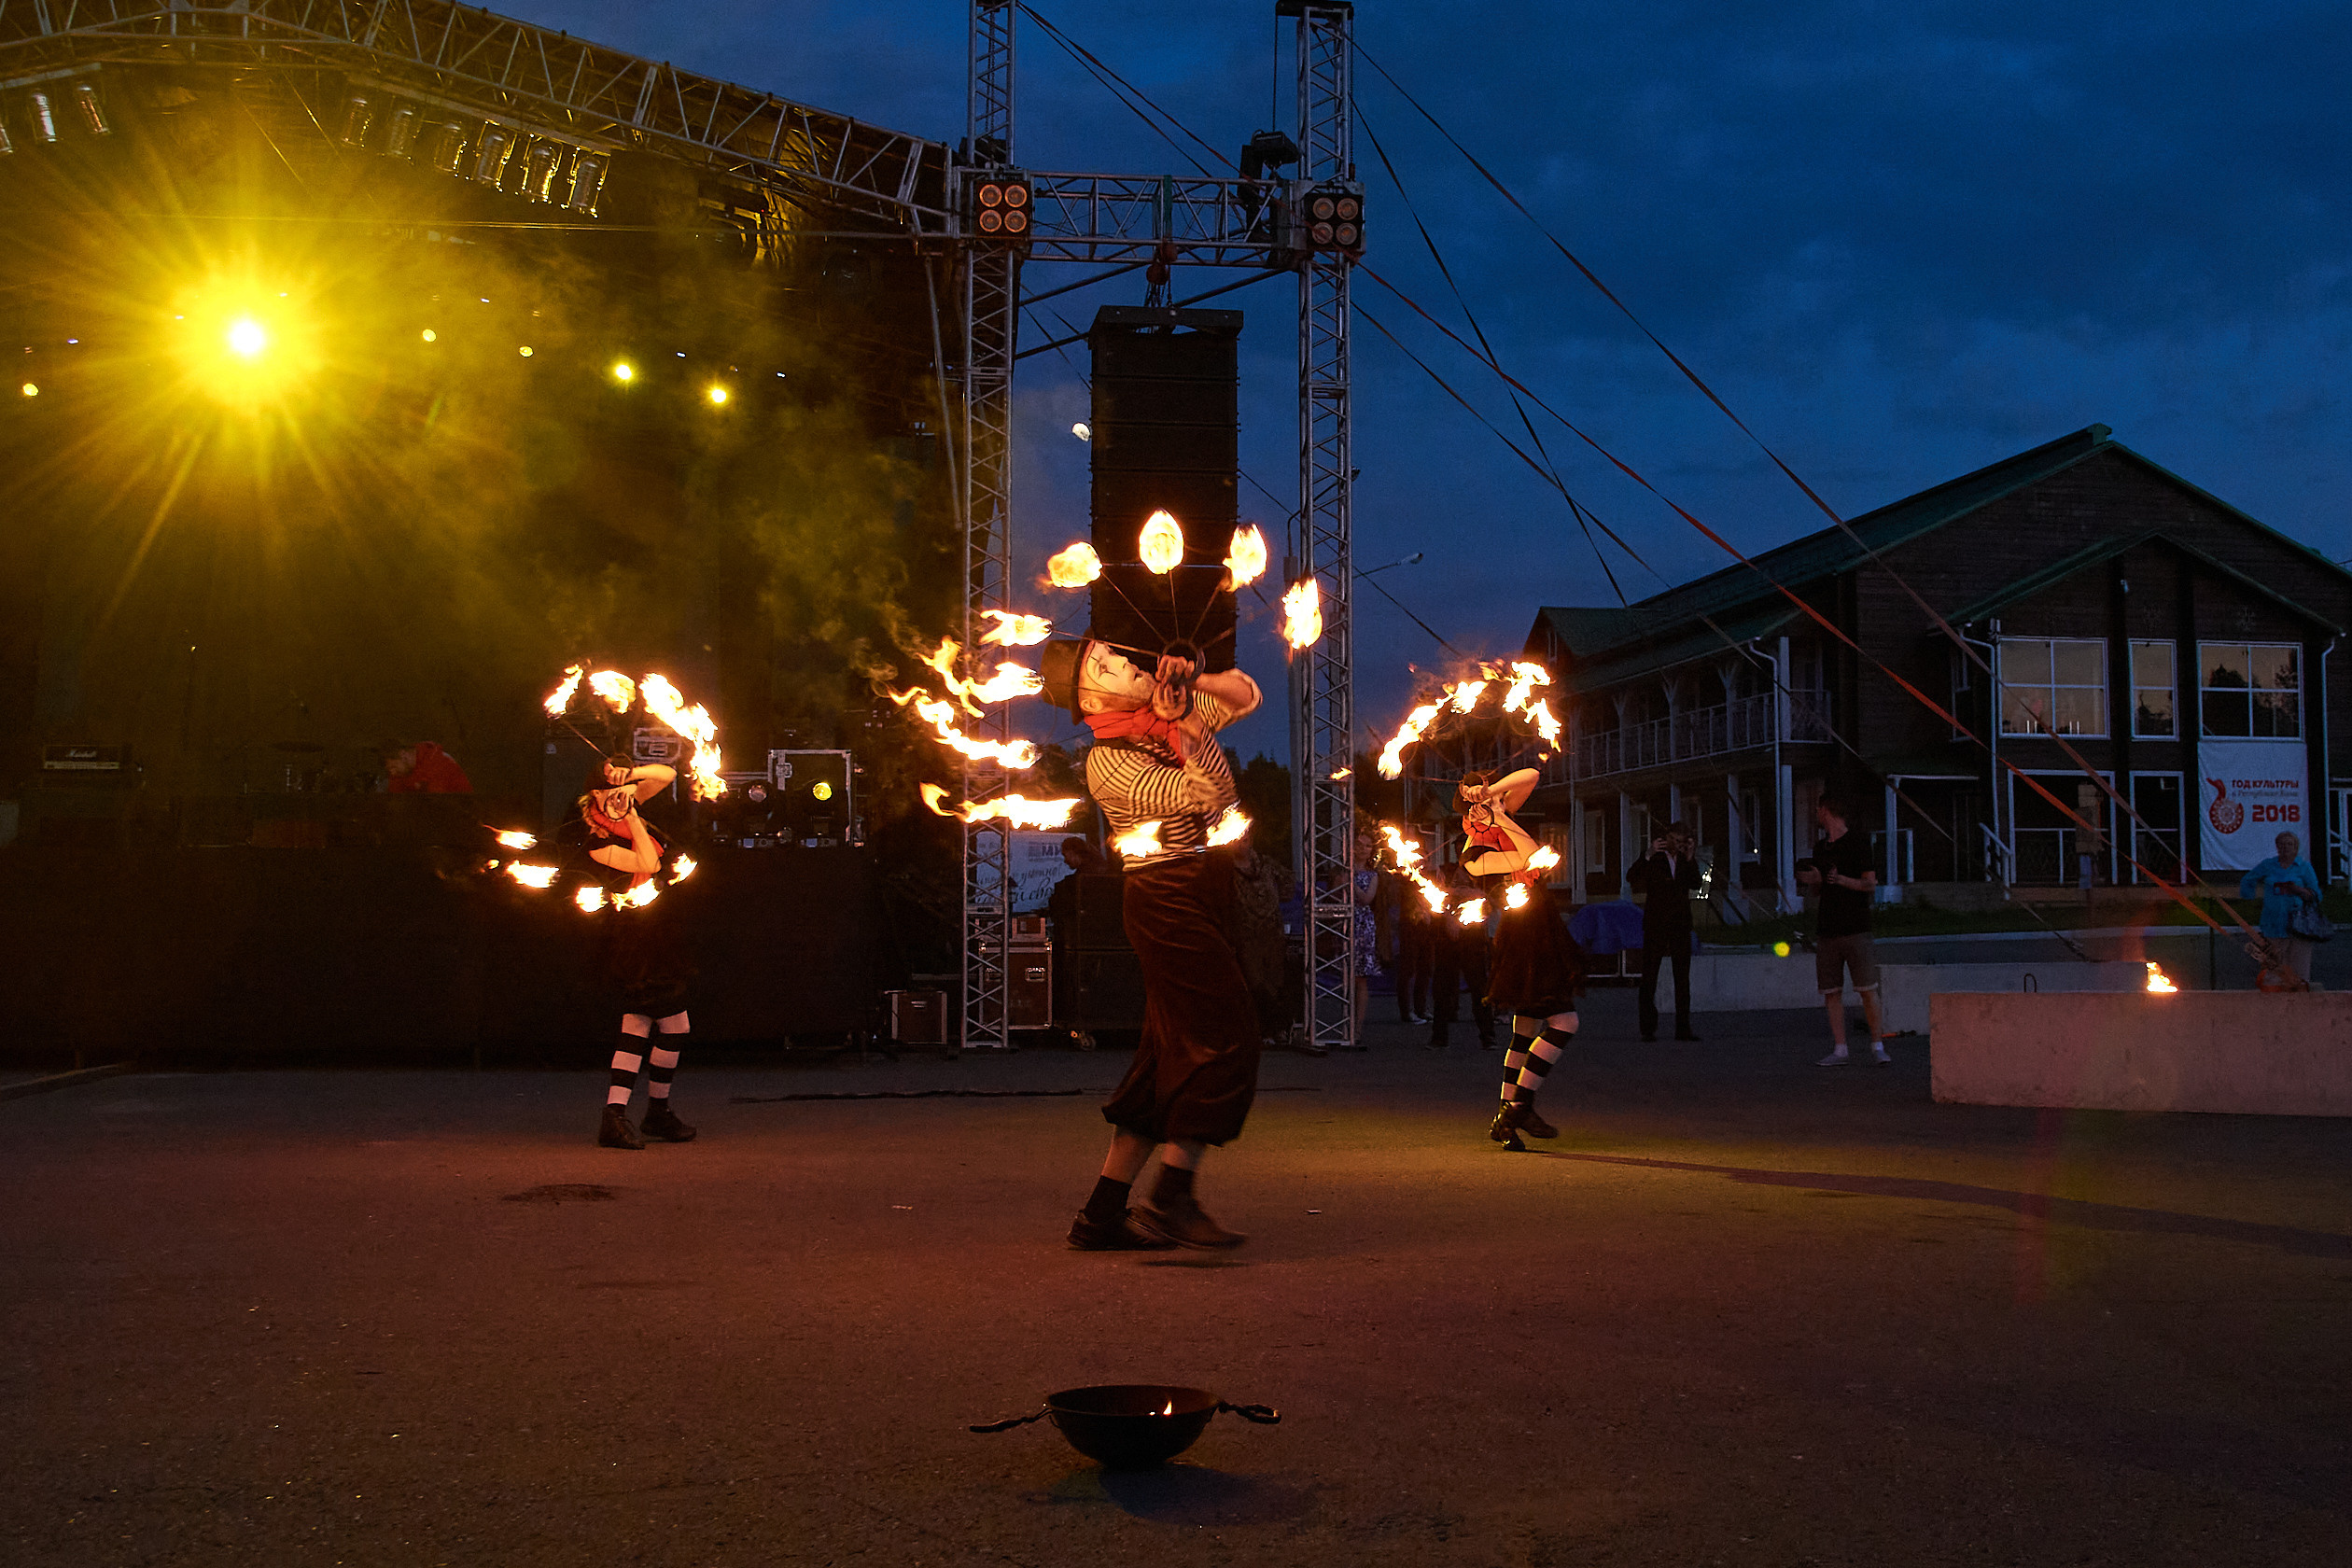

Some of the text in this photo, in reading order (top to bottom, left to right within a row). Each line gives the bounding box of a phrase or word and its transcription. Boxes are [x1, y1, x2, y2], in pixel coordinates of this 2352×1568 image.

[2232, 779, 2299, 790] ГОД КУЛЬТУРЫ
[2252, 805, 2301, 822] 2018
